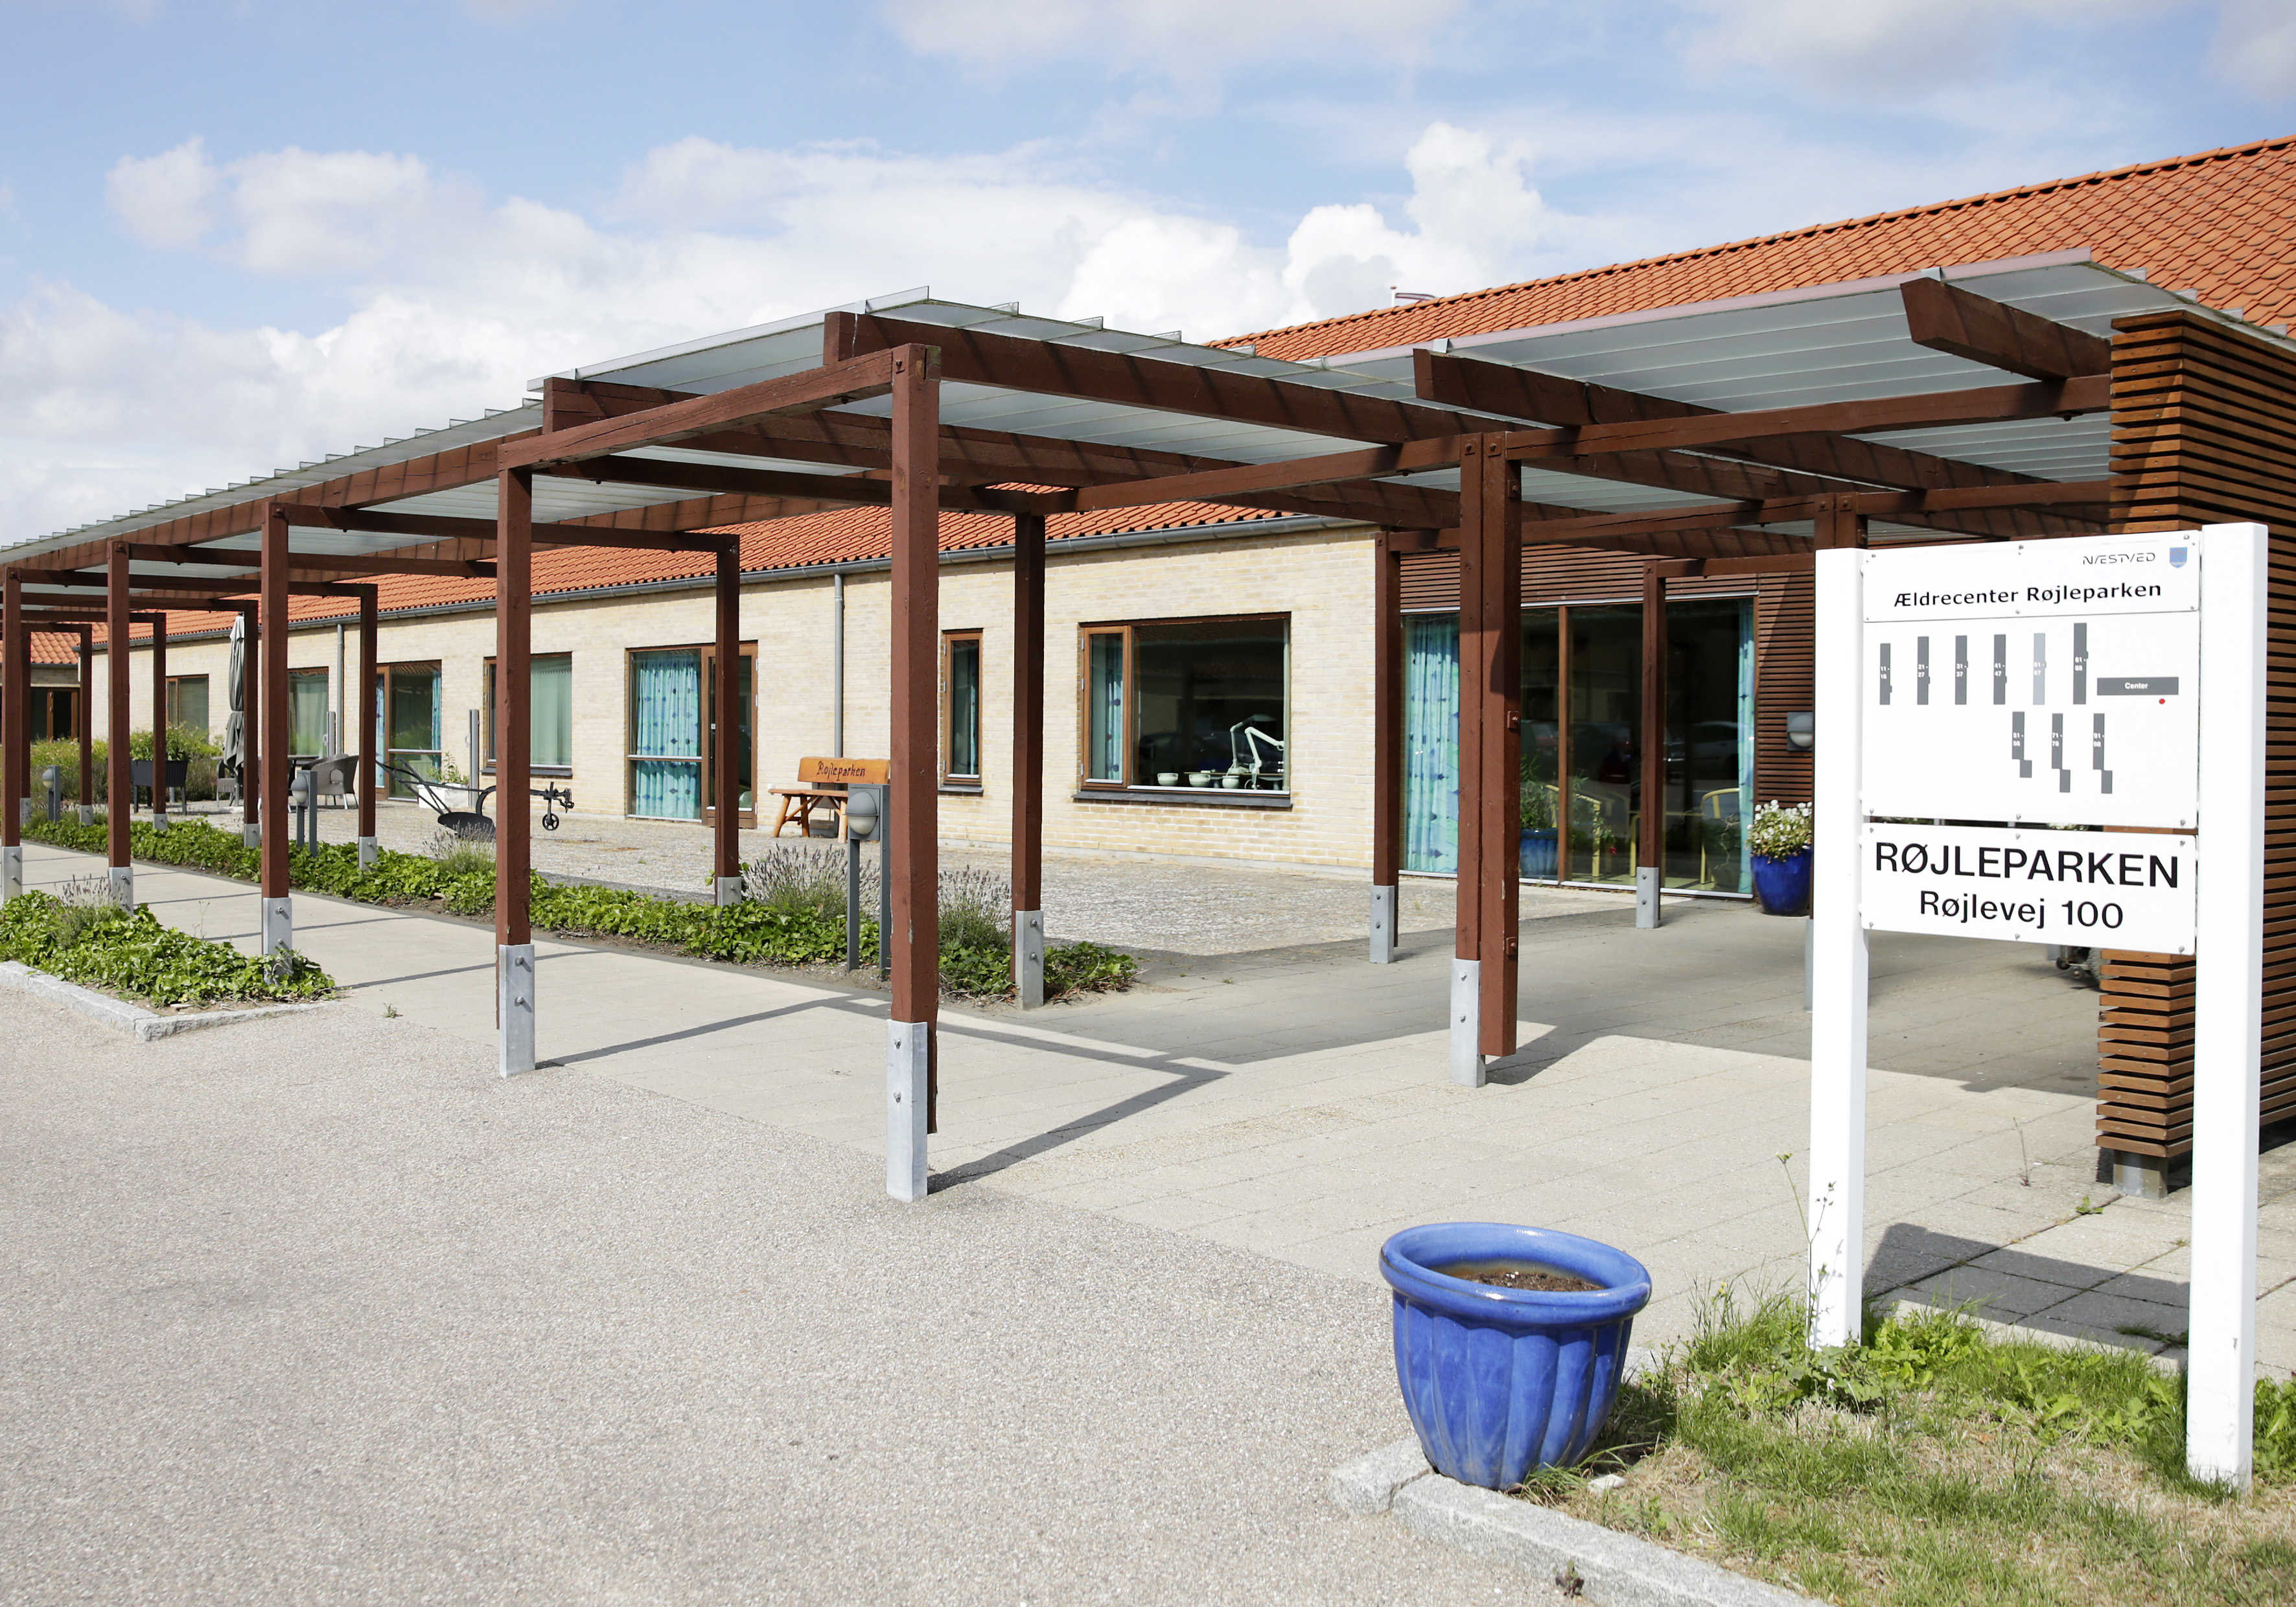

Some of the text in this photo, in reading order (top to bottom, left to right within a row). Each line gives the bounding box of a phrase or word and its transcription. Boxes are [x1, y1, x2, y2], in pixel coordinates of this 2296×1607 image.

[2083, 552, 2155, 565] NÆSTVED
[1894, 583, 2161, 607] Ældrecenter Røjleparken
[1876, 842, 2178, 888] RØJLEPARKEN
[1920, 890, 2123, 929] Røjlevej 100
